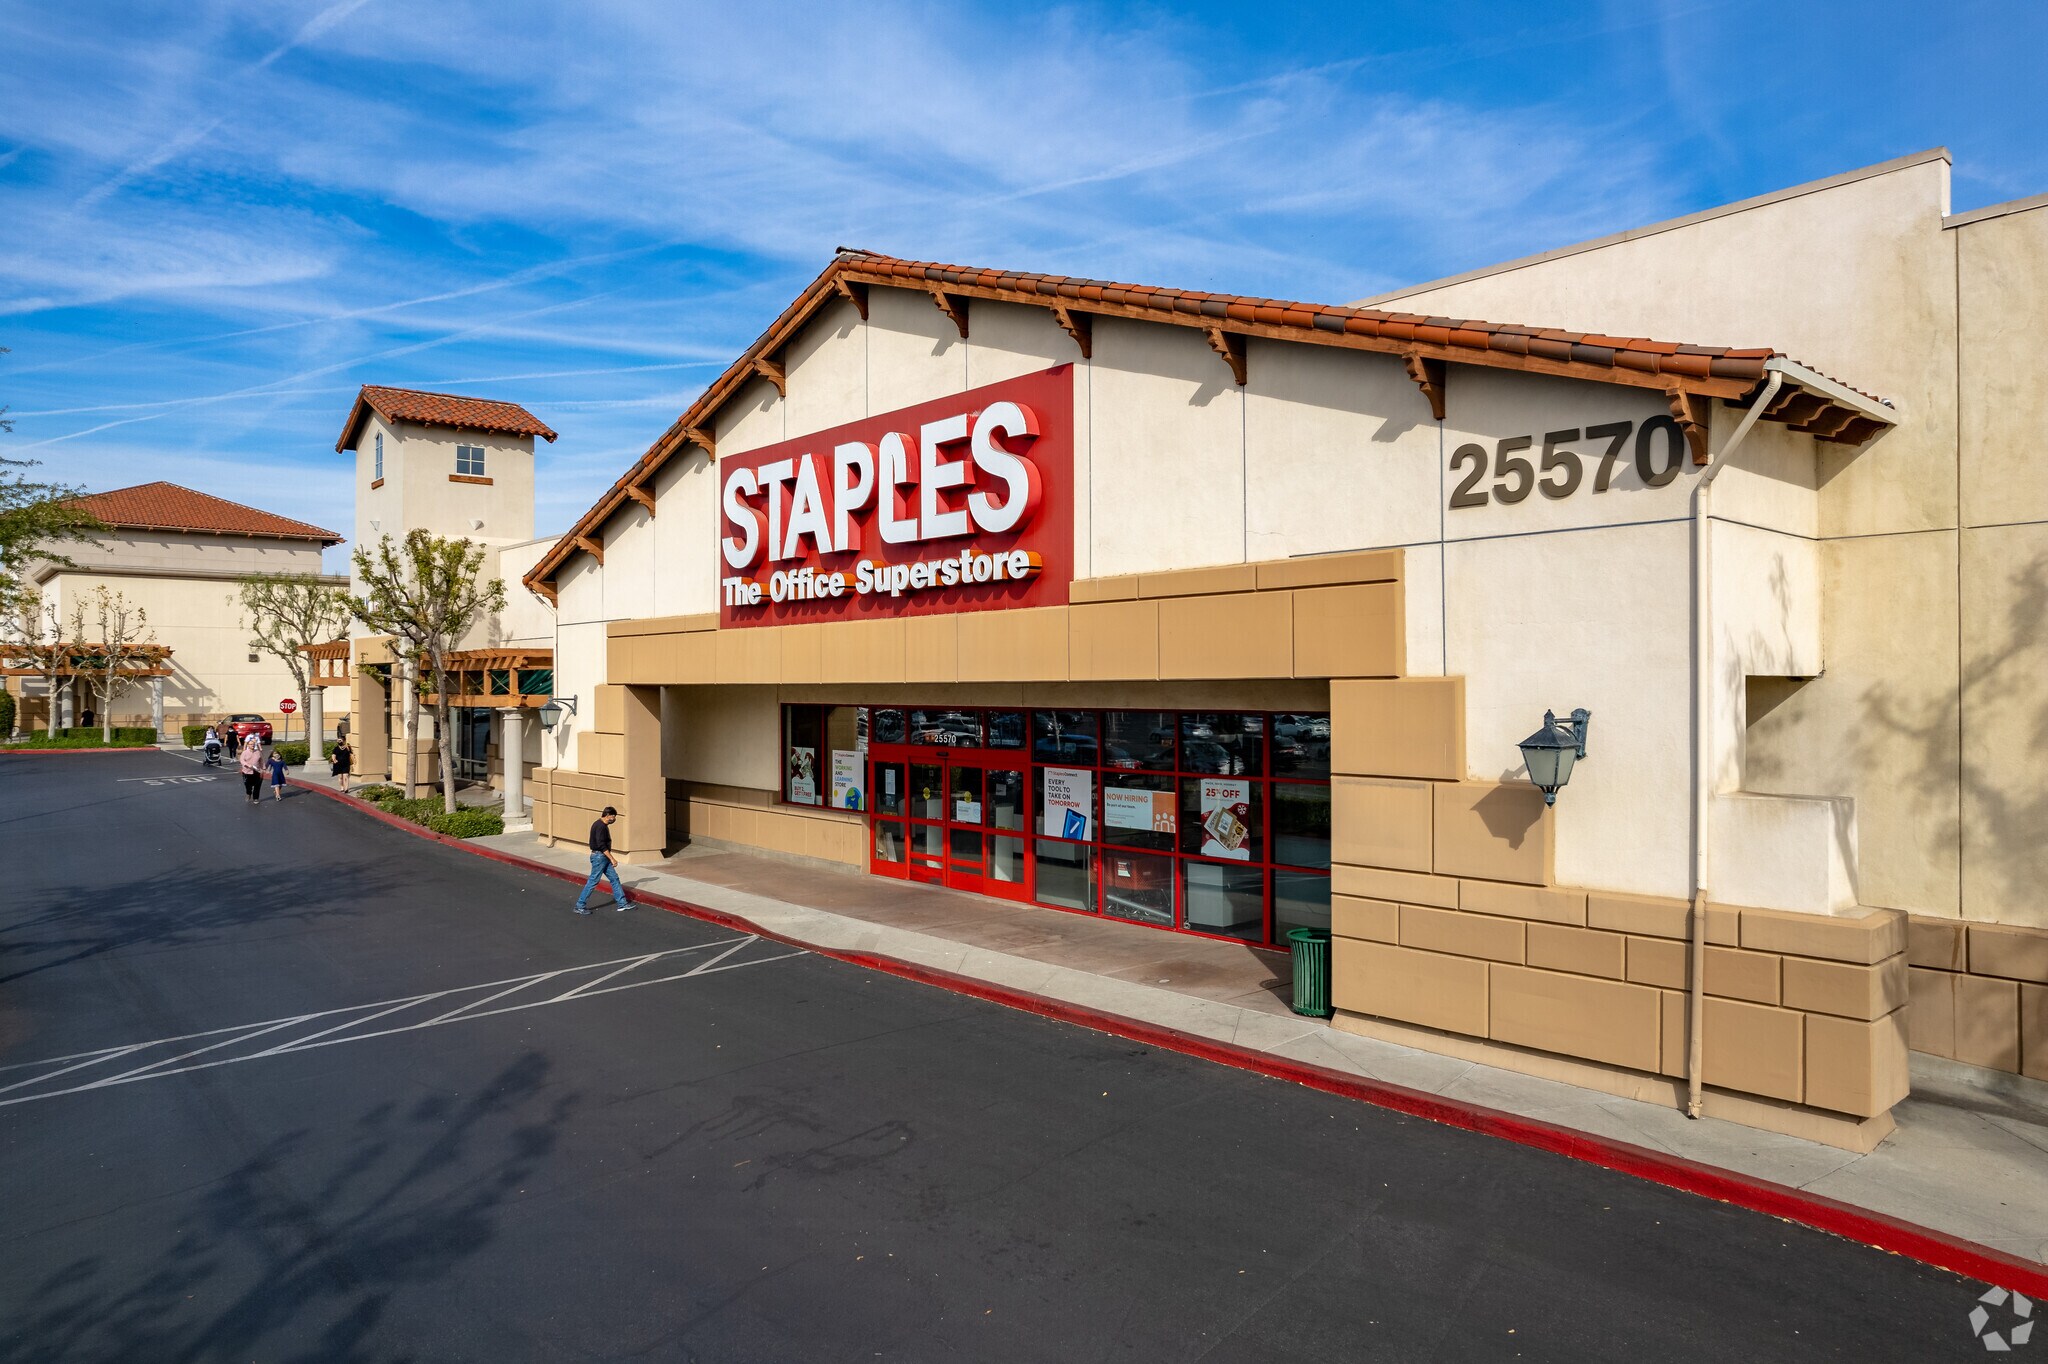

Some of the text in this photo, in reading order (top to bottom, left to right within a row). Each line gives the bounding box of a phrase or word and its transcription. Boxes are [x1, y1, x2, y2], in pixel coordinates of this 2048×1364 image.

[1449, 414, 1685, 508] 25570
[722, 401, 1036, 569] STAPLES
[723, 549, 1031, 606] The Office Superstore
[280, 702, 297, 710] STOP
[934, 734, 957, 744] 25570
[143, 776, 217, 786] STOP
[1106, 793, 1149, 803] NOW HIRING
[1222, 789, 1240, 799] OFF
[1048, 799, 1080, 808] TOMORROW
